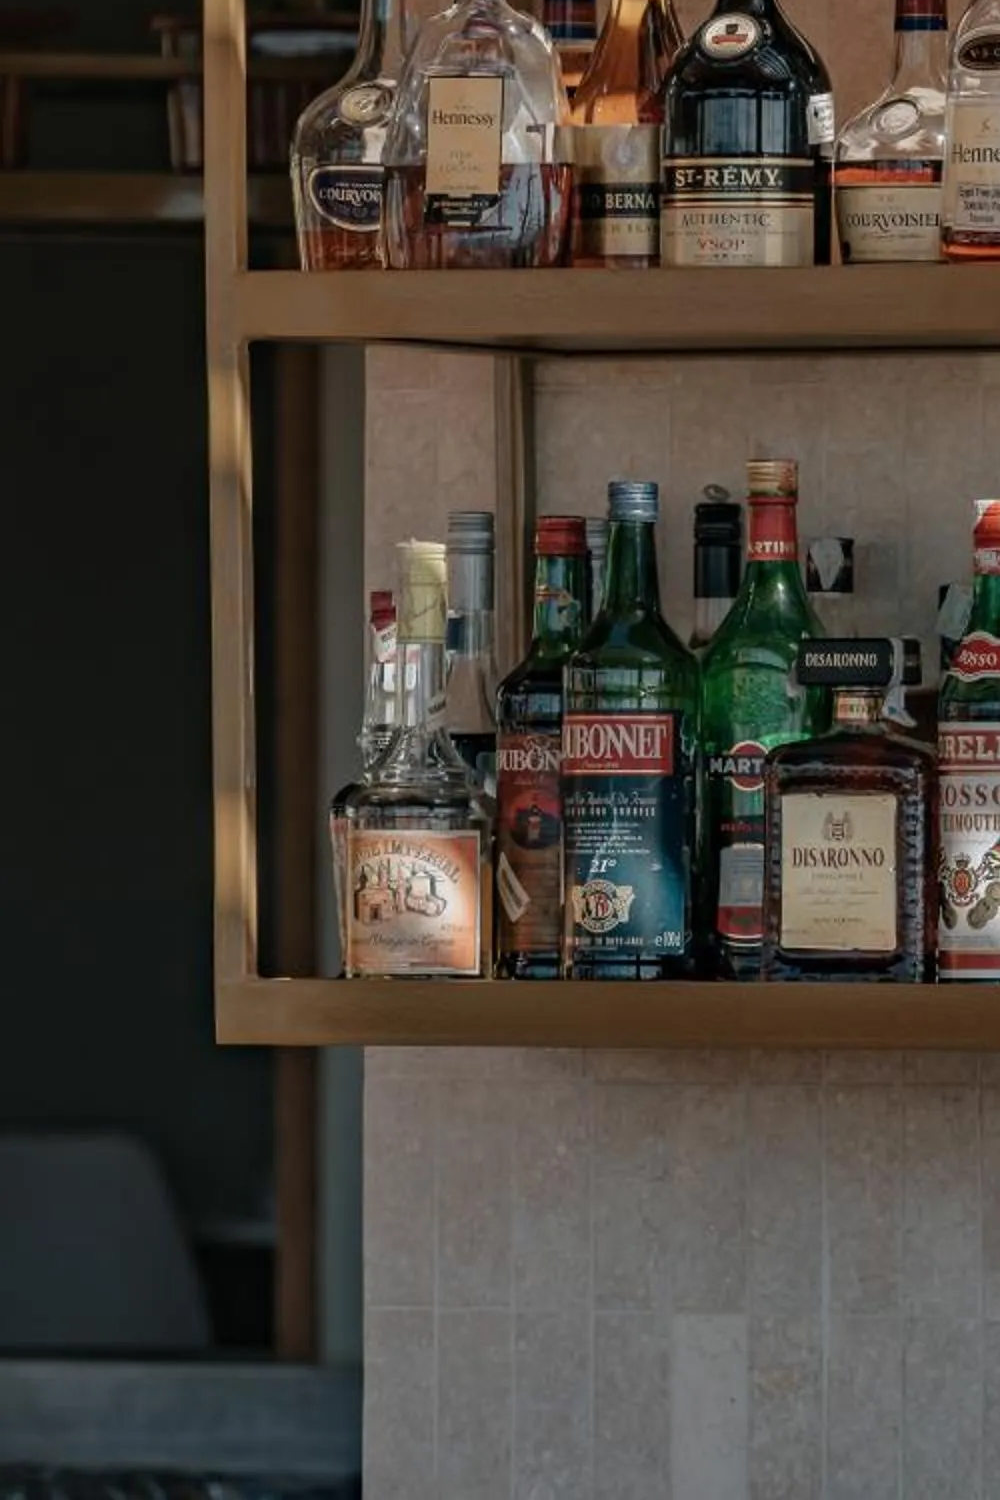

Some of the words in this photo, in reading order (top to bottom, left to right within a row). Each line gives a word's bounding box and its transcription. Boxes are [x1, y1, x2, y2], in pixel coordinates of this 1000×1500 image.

[432, 109, 496, 129] Hennessy
[681, 212, 771, 227] AUTHENTIC
[805, 653, 877, 667] DISARONNO
[562, 724, 667, 760] UBONNET
[791, 847, 885, 869] DISARONNO
